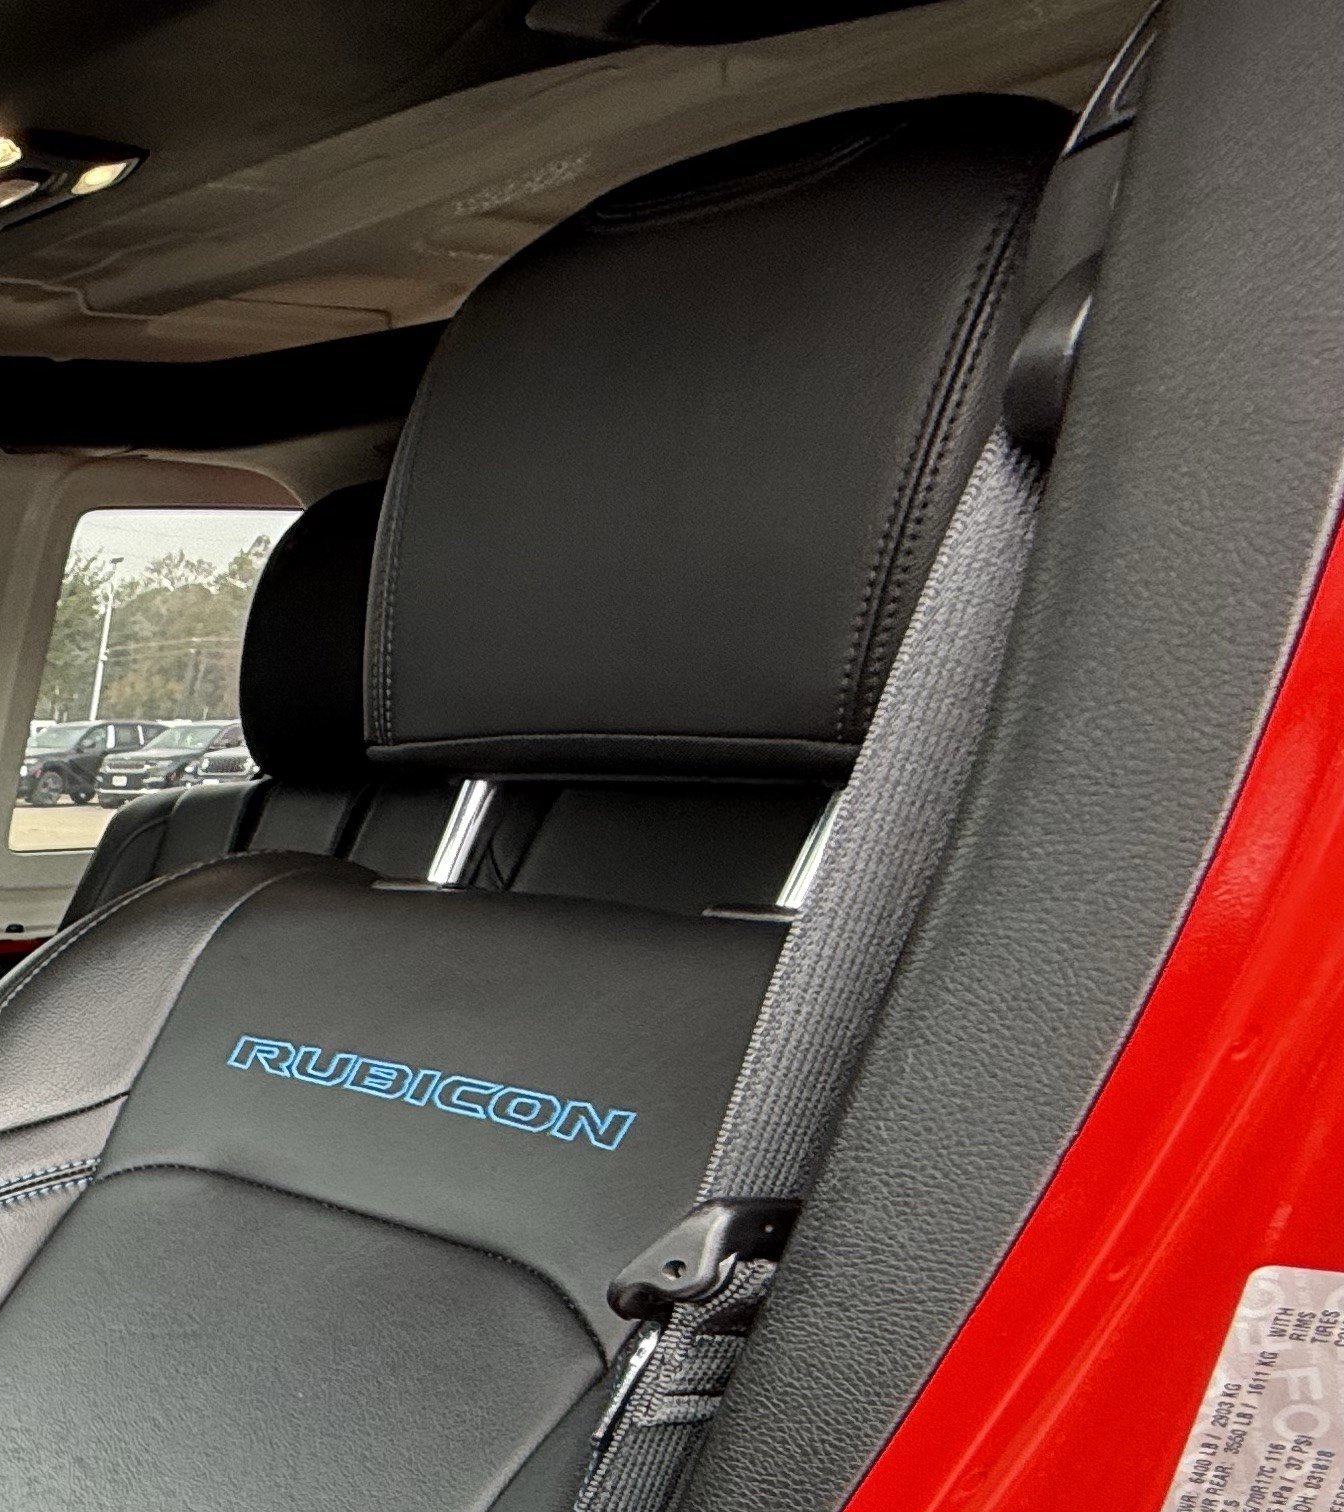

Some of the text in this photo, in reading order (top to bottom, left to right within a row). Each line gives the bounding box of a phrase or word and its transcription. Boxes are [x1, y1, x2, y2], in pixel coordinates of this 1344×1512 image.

[227, 1035, 637, 1150] RUBICON
[1266, 1306, 1295, 1337] WITH
[1287, 1311, 1317, 1341] RIMS
[1255, 1351, 1279, 1366] KG
[1220, 1382, 1242, 1397] KG
[1263, 1442, 1286, 1462] 116
[1309, 1310, 1341, 1345] TIRES
[1208, 1400, 1235, 1427] 2903
[1233, 1411, 1254, 1426] LB
[1290, 1434, 1314, 1452] PSI
[1284, 1457, 1304, 1470] 37
[1269, 1484, 1293, 1504] kPa
